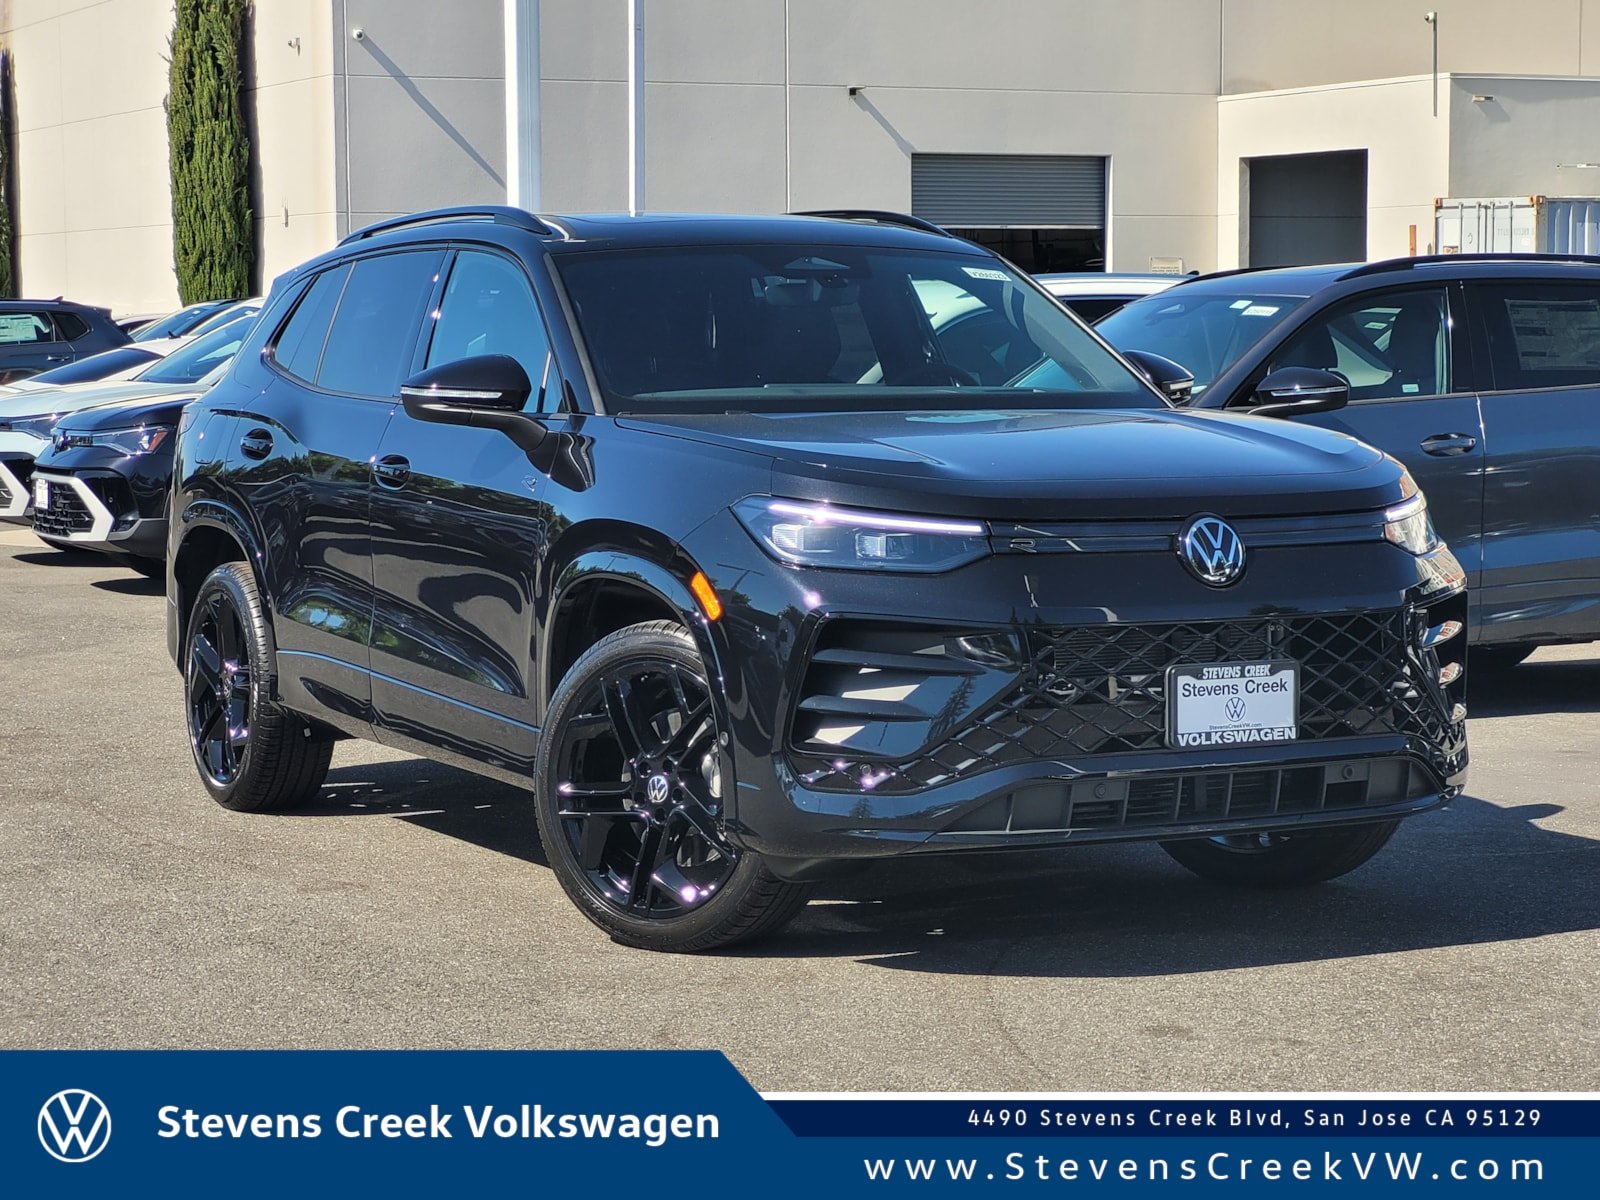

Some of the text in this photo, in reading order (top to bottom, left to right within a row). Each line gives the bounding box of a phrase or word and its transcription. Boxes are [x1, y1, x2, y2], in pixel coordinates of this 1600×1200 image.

[1185, 517, 1243, 584] VW
[1202, 664, 1271, 680] STEVENS CREEK
[1182, 678, 1288, 698] Stevens Creek
[1224, 697, 1246, 722] VW
[1177, 727, 1297, 747] VOLKSWAGEN
[648, 775, 669, 803] VW
